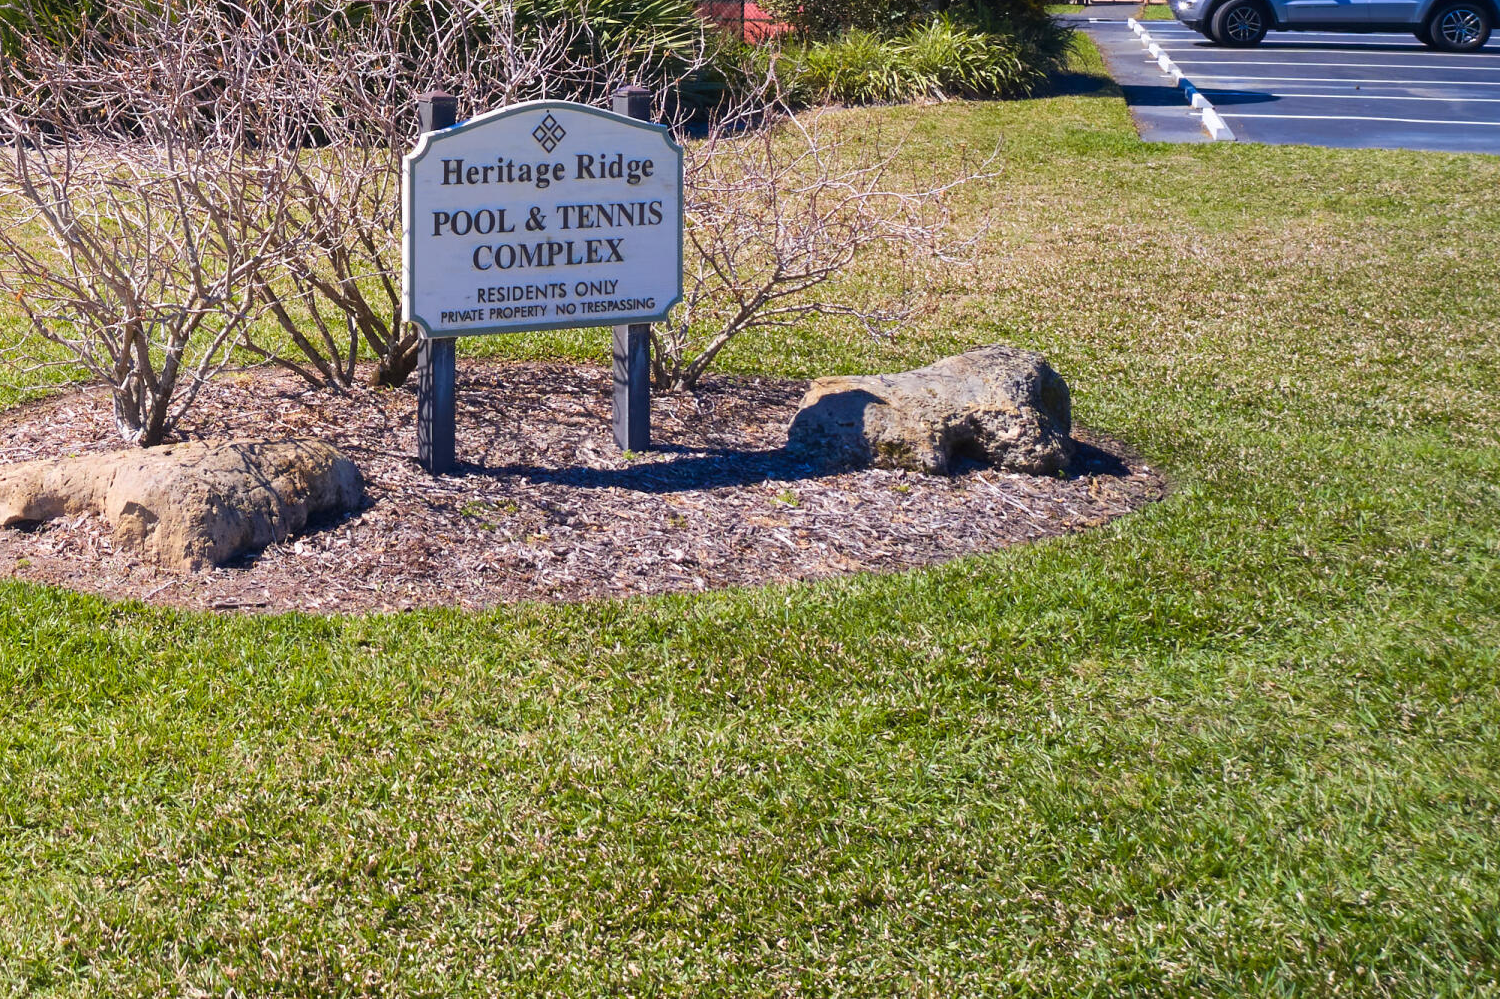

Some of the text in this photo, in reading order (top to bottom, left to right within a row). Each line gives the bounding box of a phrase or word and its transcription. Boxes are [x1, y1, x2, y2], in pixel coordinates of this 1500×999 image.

[441, 153, 654, 189] Heritage Ridge
[432, 201, 663, 236] POOL & TENNIS
[472, 238, 625, 271] COMPLEX
[478, 279, 619, 303] RESIDENTS ONLY
[441, 297, 656, 323] PRIVATE PROPERTY NO TRESPASSING
